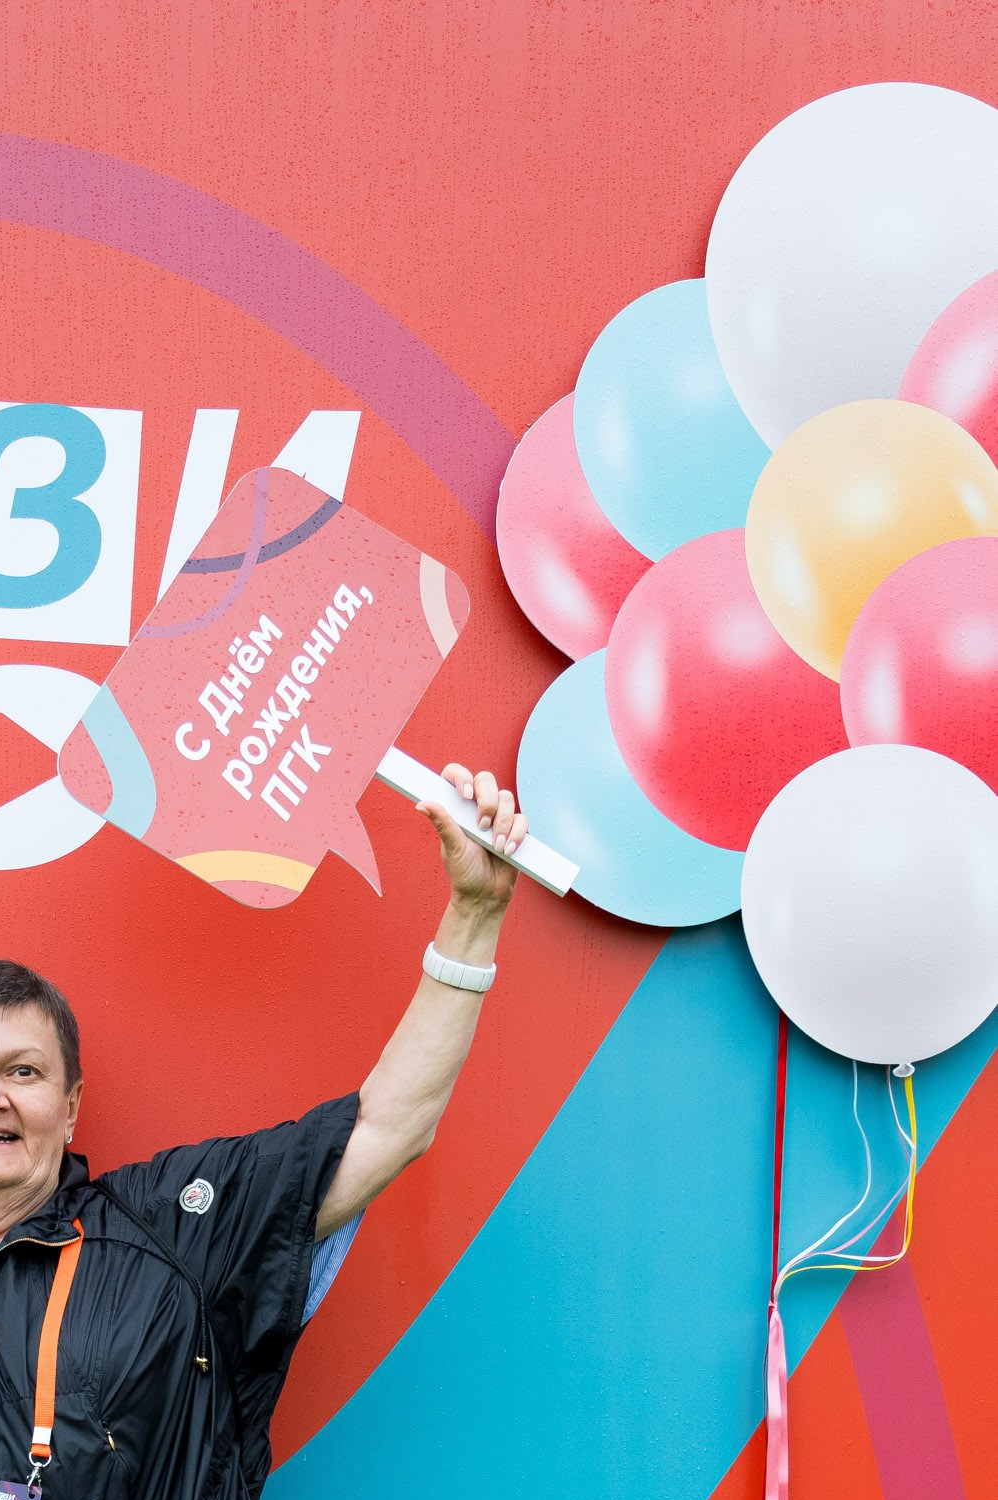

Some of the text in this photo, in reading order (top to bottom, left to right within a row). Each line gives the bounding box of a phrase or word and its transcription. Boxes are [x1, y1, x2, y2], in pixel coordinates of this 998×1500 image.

[198, 614, 284, 735] Днём
[221, 583, 374, 801] рождения,
[259, 724, 333, 823] ПГК
